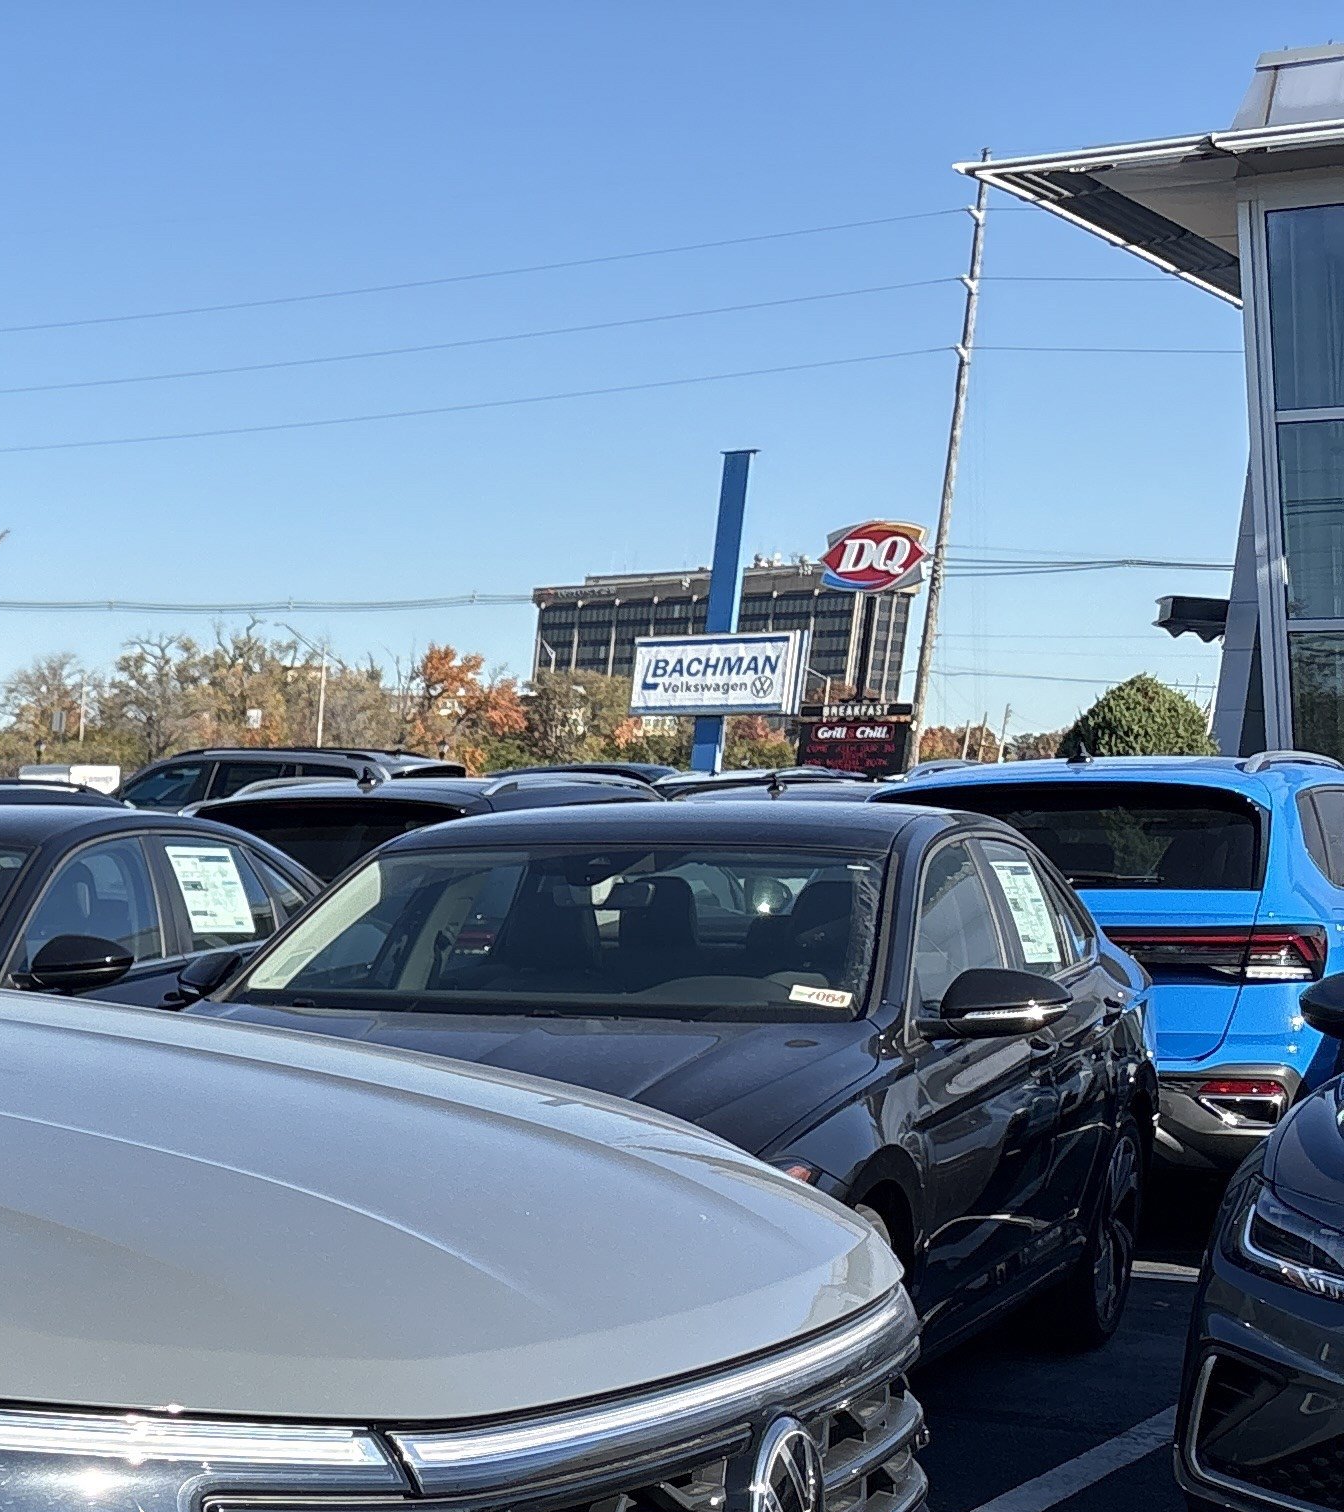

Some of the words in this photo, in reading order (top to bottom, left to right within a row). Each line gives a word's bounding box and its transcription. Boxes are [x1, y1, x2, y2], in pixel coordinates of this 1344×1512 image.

[836, 536, 911, 575] DQ
[651, 655, 781, 679] BACHMAN
[662, 681, 748, 695] Volkswagen
[822, 704, 889, 717] BREAKFAST
[817, 726, 847, 739] Grill
